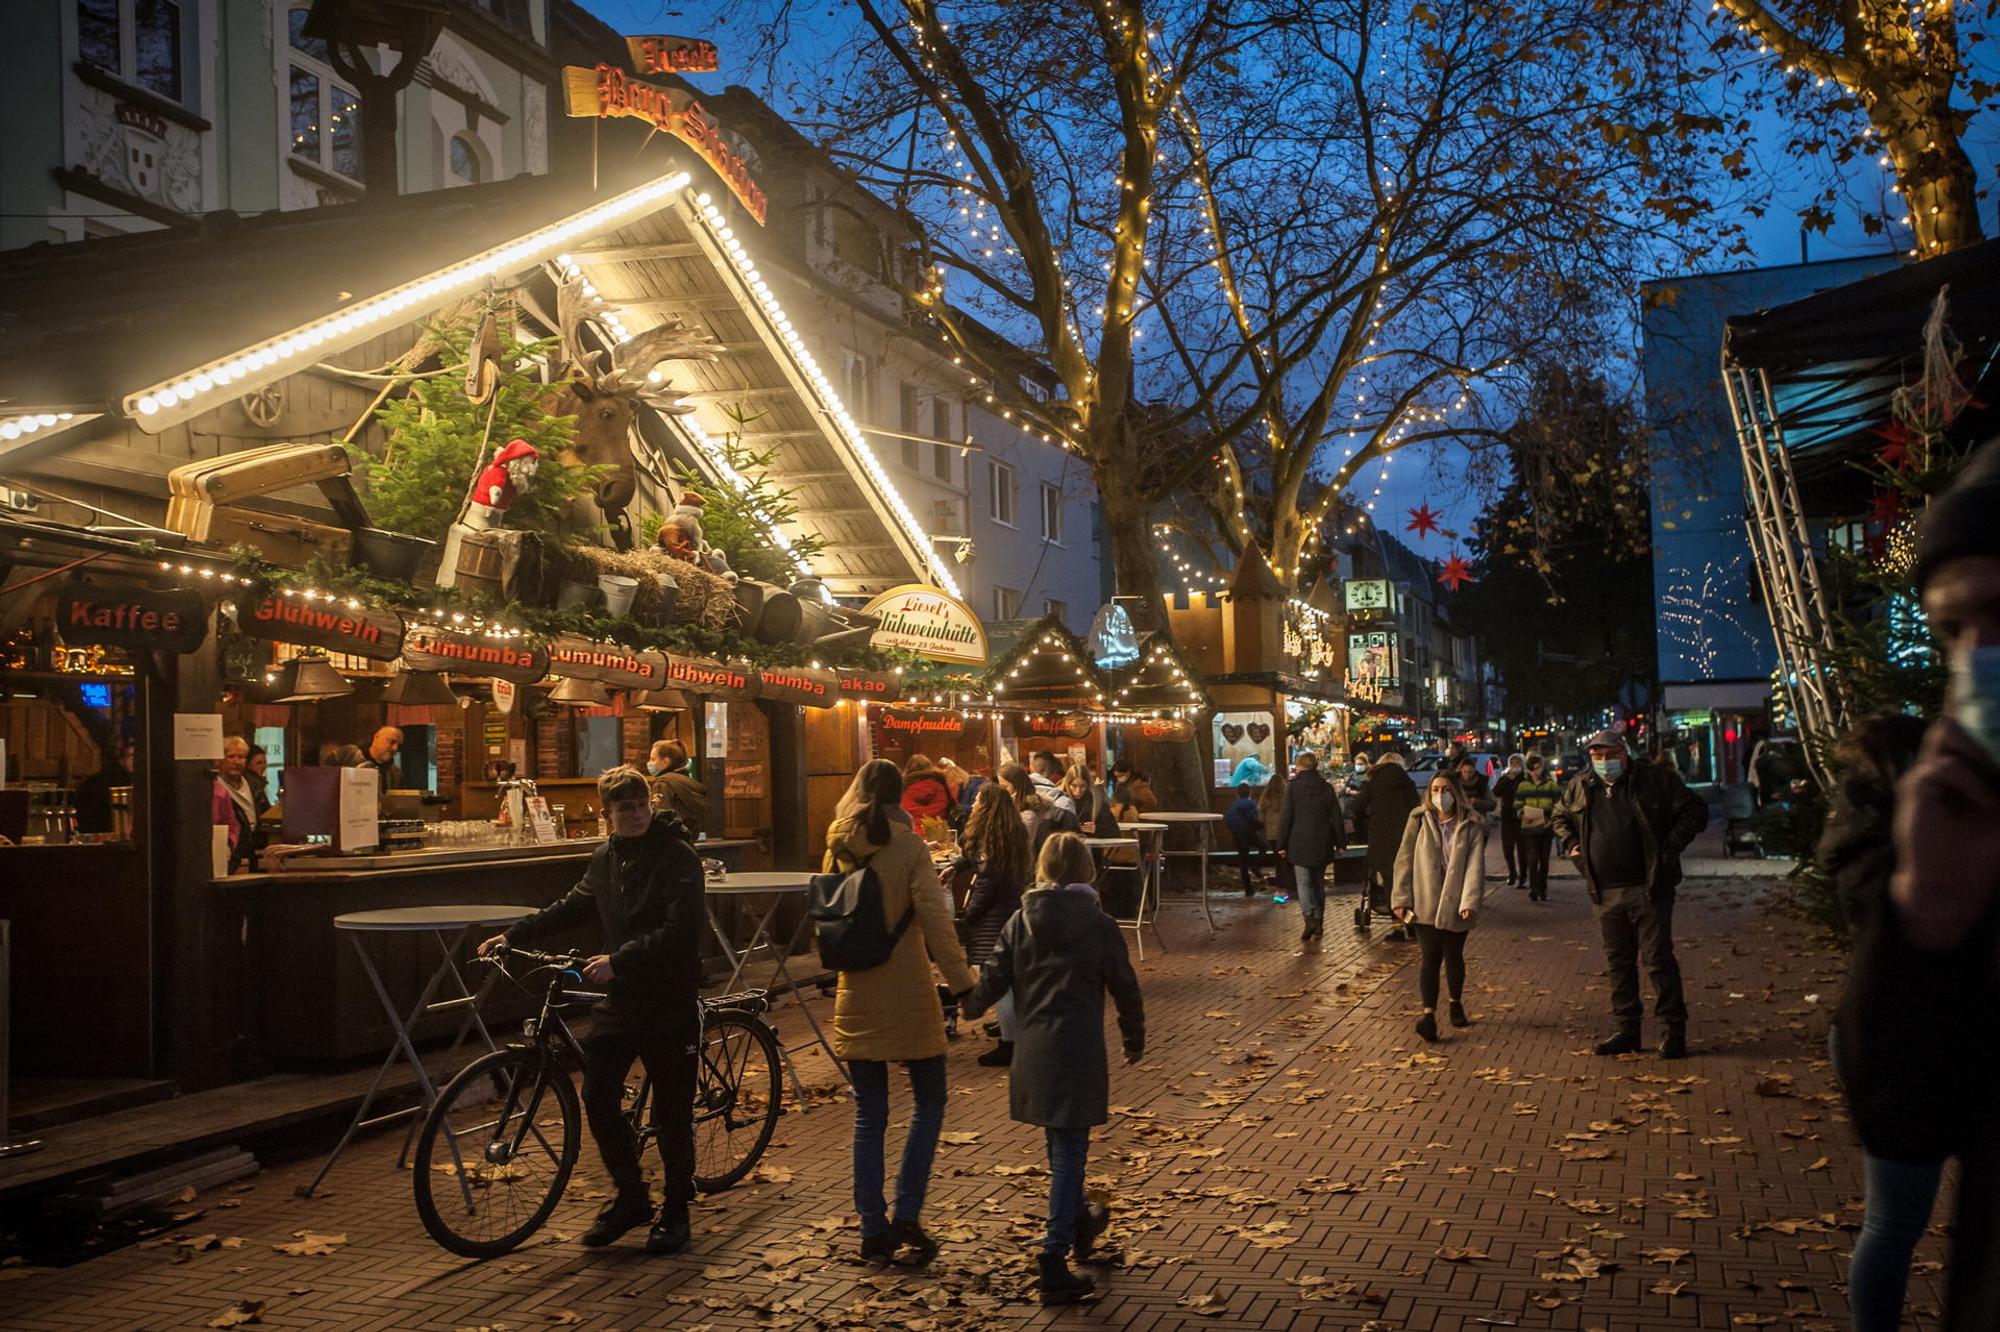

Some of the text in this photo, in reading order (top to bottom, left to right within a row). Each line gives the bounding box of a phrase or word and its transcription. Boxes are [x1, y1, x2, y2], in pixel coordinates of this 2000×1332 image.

[70, 600, 181, 632] Kaffee
[255, 598, 380, 644] Glühwein
[901, 597, 949, 619] Liesel's
[414, 635, 534, 668] Lumumba
[546, 643, 654, 678] Lumumba
[668, 662, 747, 689] lühwein
[760, 671, 826, 696] mumba
[841, 676, 887, 693] akao
[882, 713, 961, 734] Dampfnudeln
